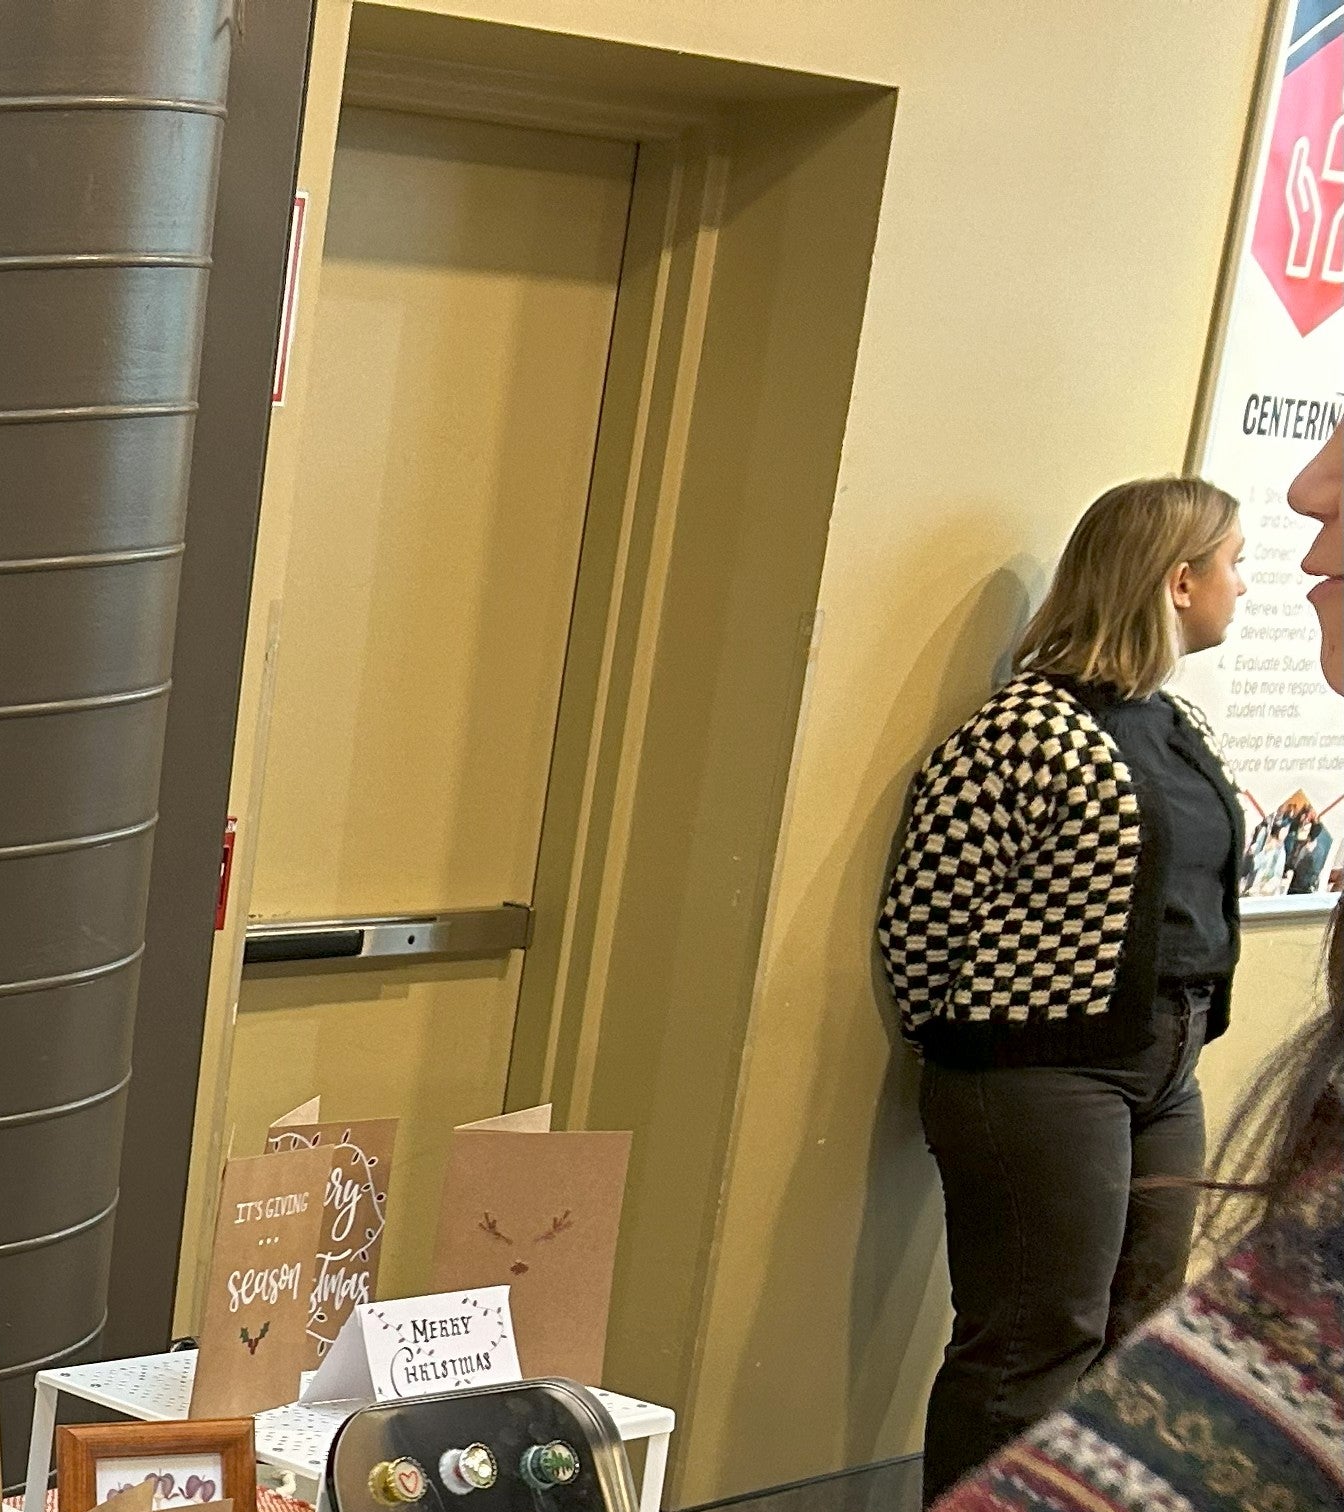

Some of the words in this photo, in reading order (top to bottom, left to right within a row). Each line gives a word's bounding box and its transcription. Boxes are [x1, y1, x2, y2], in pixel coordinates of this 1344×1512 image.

[1242, 393, 1342, 440] CENTERIN
[1240, 624, 1307, 643] development
[1234, 654, 1280, 672] Evaluate
[1281, 655, 1317, 672] Studen
[1231, 678, 1241, 694] to
[1244, 679, 1258, 695] be
[1260, 680, 1286, 694] more
[1287, 682, 1328, 696] respons
[1226, 702, 1267, 718] student
[1220, 732, 1262, 751] Develop
[1265, 733, 1282, 748] the
[1284, 732, 1318, 748] alumni
[1263, 756, 1278, 772] for
[1279, 757, 1315, 772] current
[234, 1199, 263, 1224] IT'S
[265, 1191, 309, 1219] GIVING
[227, 1262, 301, 1313] season
[411, 1315, 472, 1343] MERRY
[390, 1346, 491, 1397] CHRISTMAS
